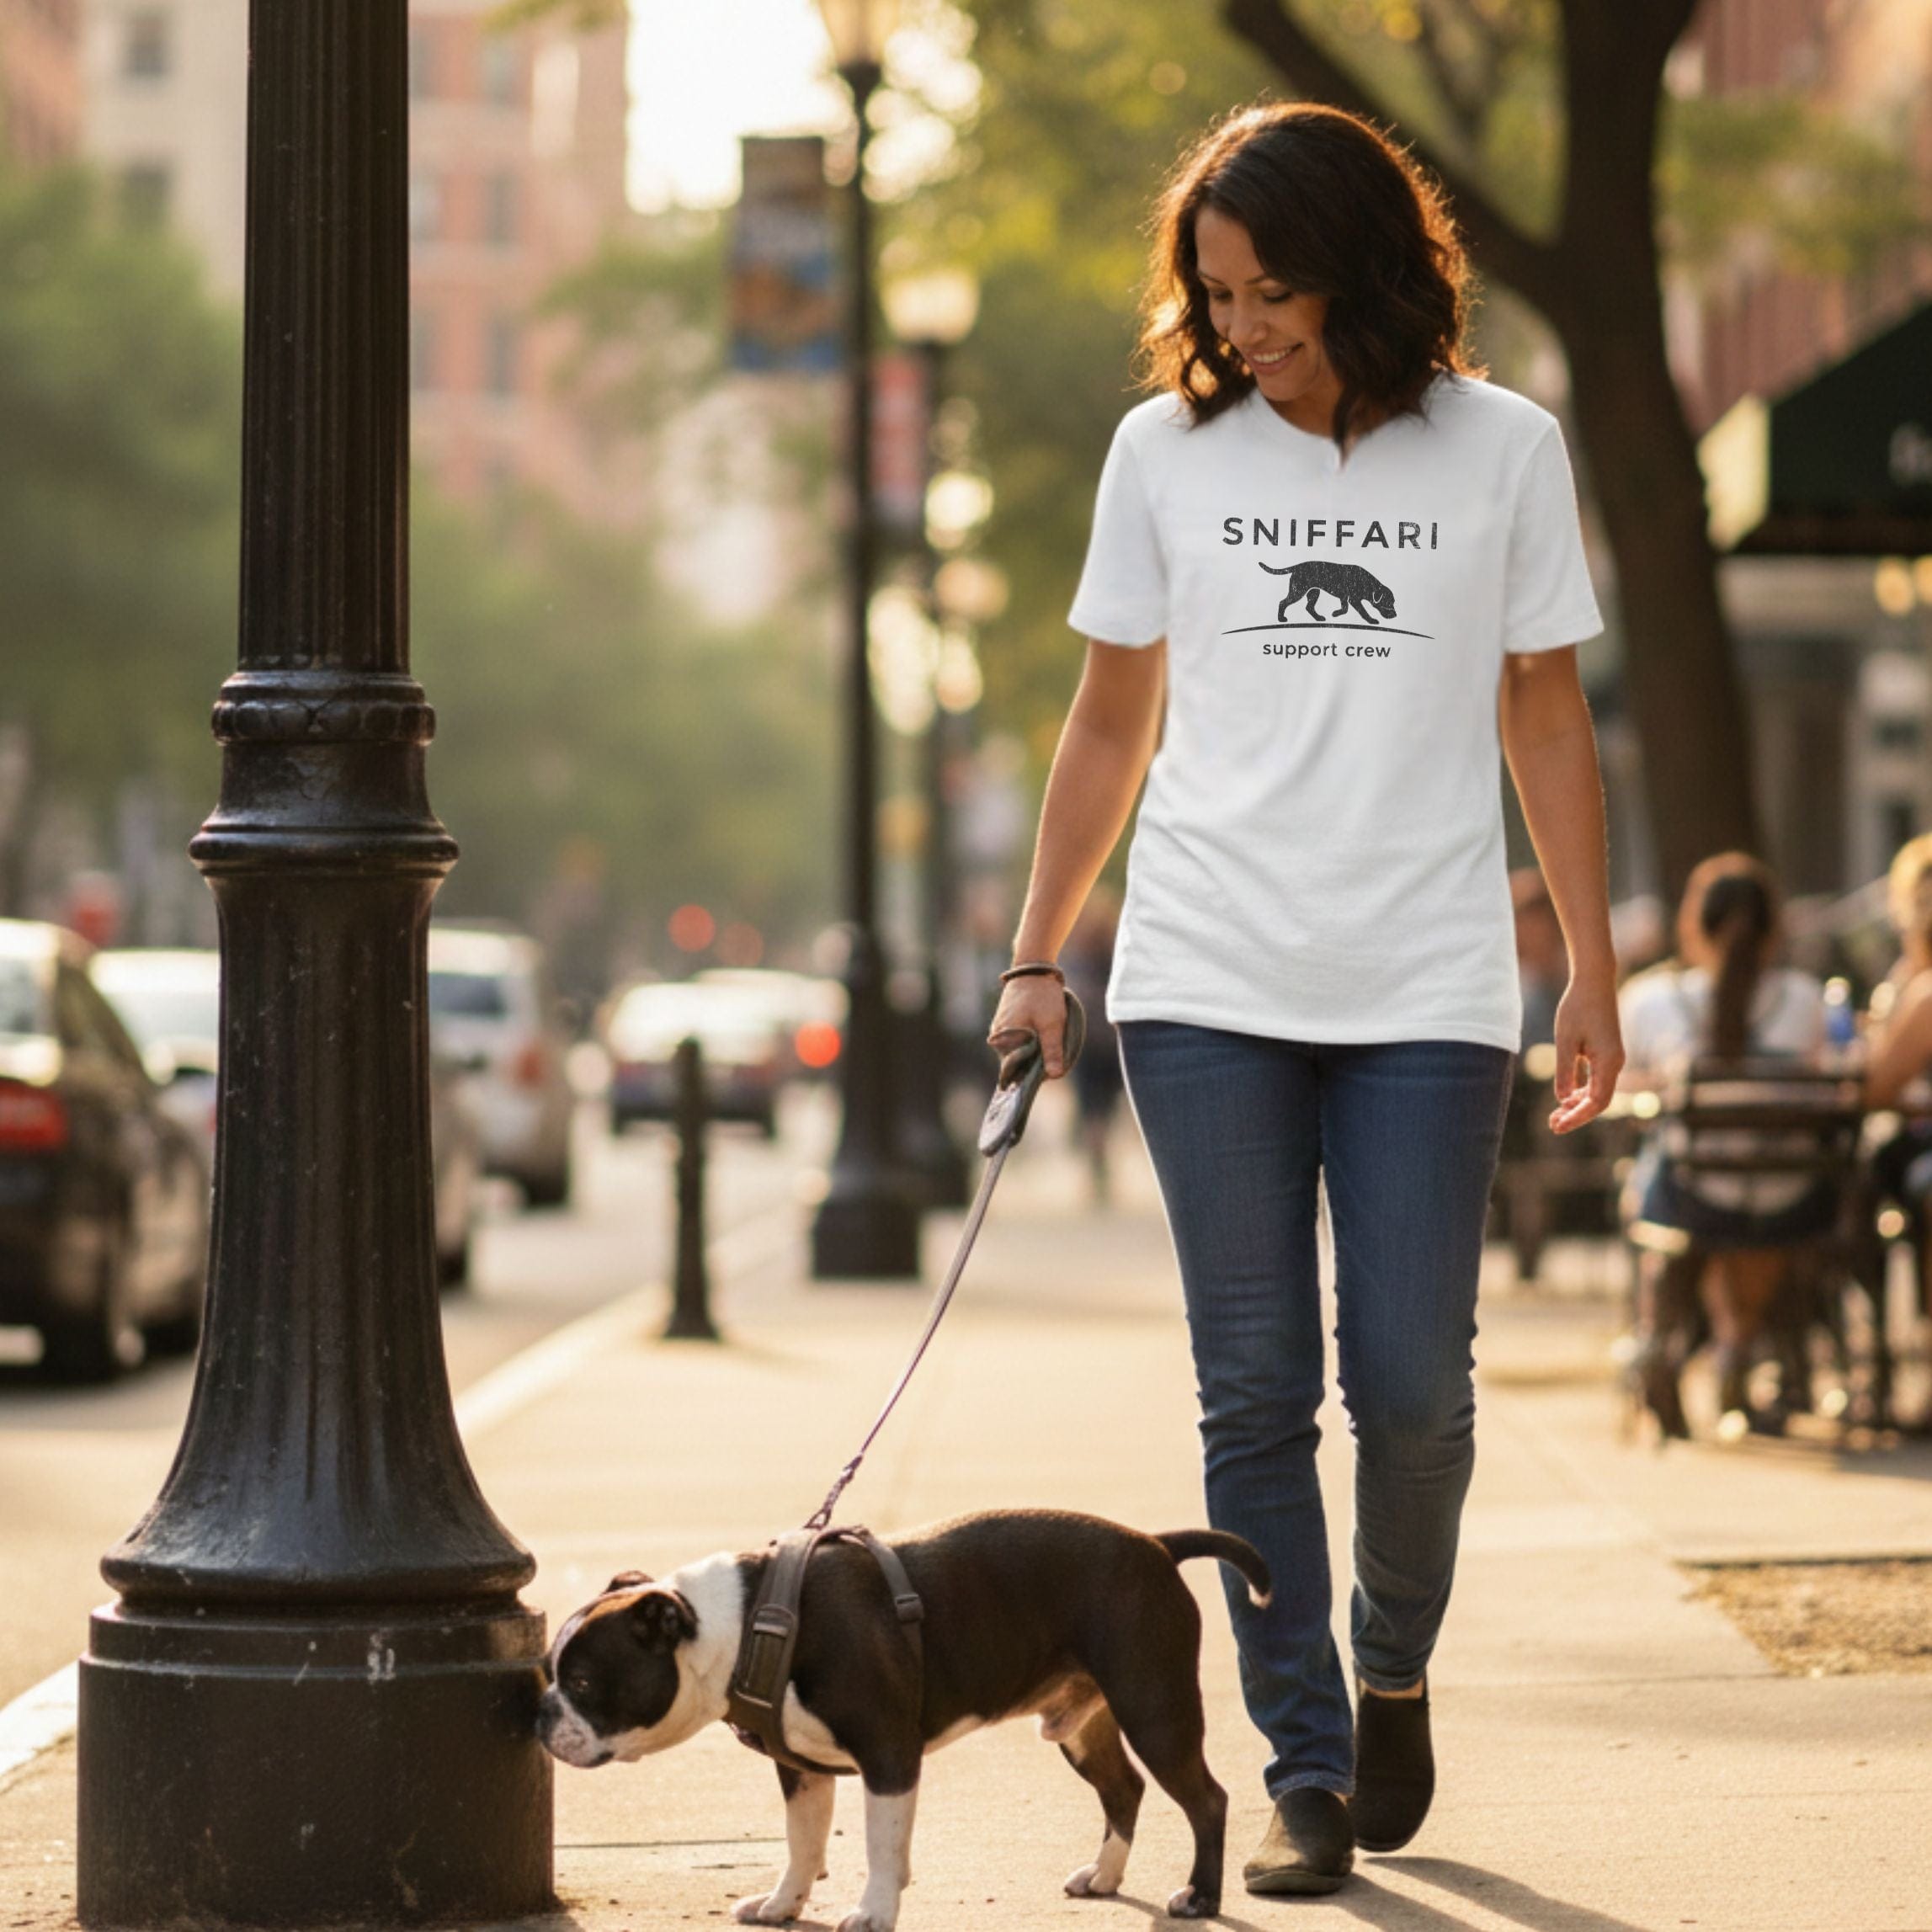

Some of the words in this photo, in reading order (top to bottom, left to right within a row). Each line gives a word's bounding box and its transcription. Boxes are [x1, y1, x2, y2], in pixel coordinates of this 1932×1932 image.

[1222, 517, 1438, 550] SNIFFARI
[1263, 643, 1338, 659] support
[1345, 646, 1392, 657] crew
